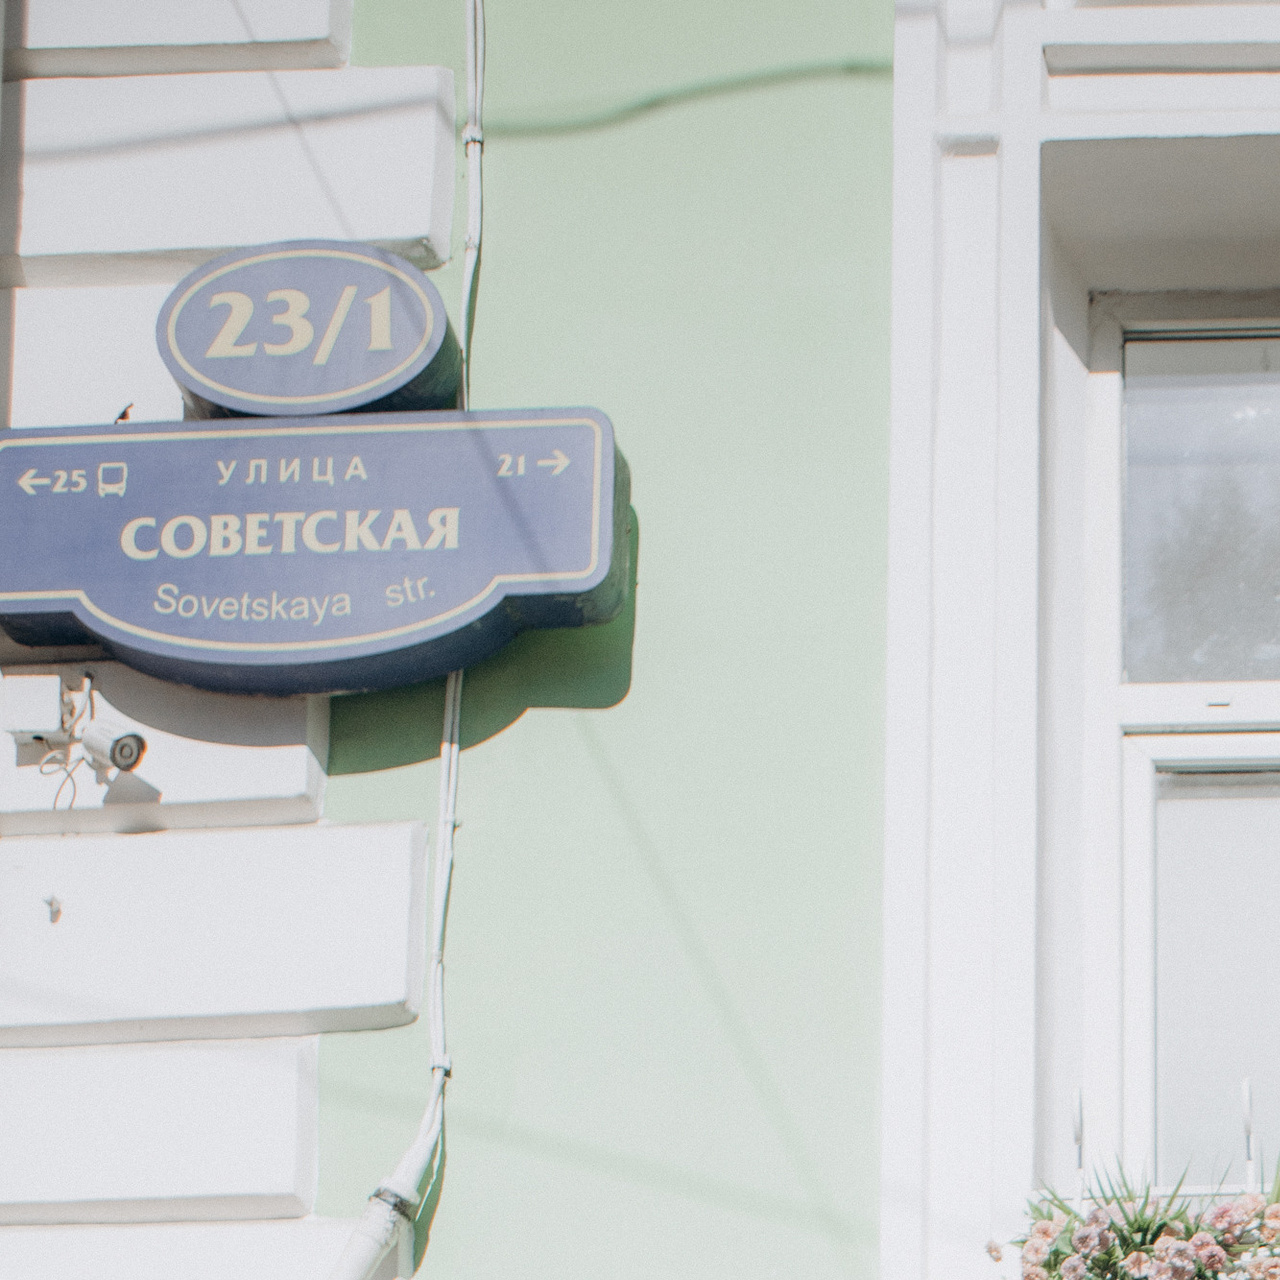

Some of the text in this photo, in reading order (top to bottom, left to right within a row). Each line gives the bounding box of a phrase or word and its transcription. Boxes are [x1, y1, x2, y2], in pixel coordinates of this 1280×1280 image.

[203, 284, 396, 367] 23/1
[50, 469, 88, 494] 25
[216, 455, 369, 487] УЛИЦА
[497, 453, 528, 478] 21
[119, 506, 461, 562] СОВЕТСКАЯ
[153, 577, 437, 627] Sovetskaya str.
